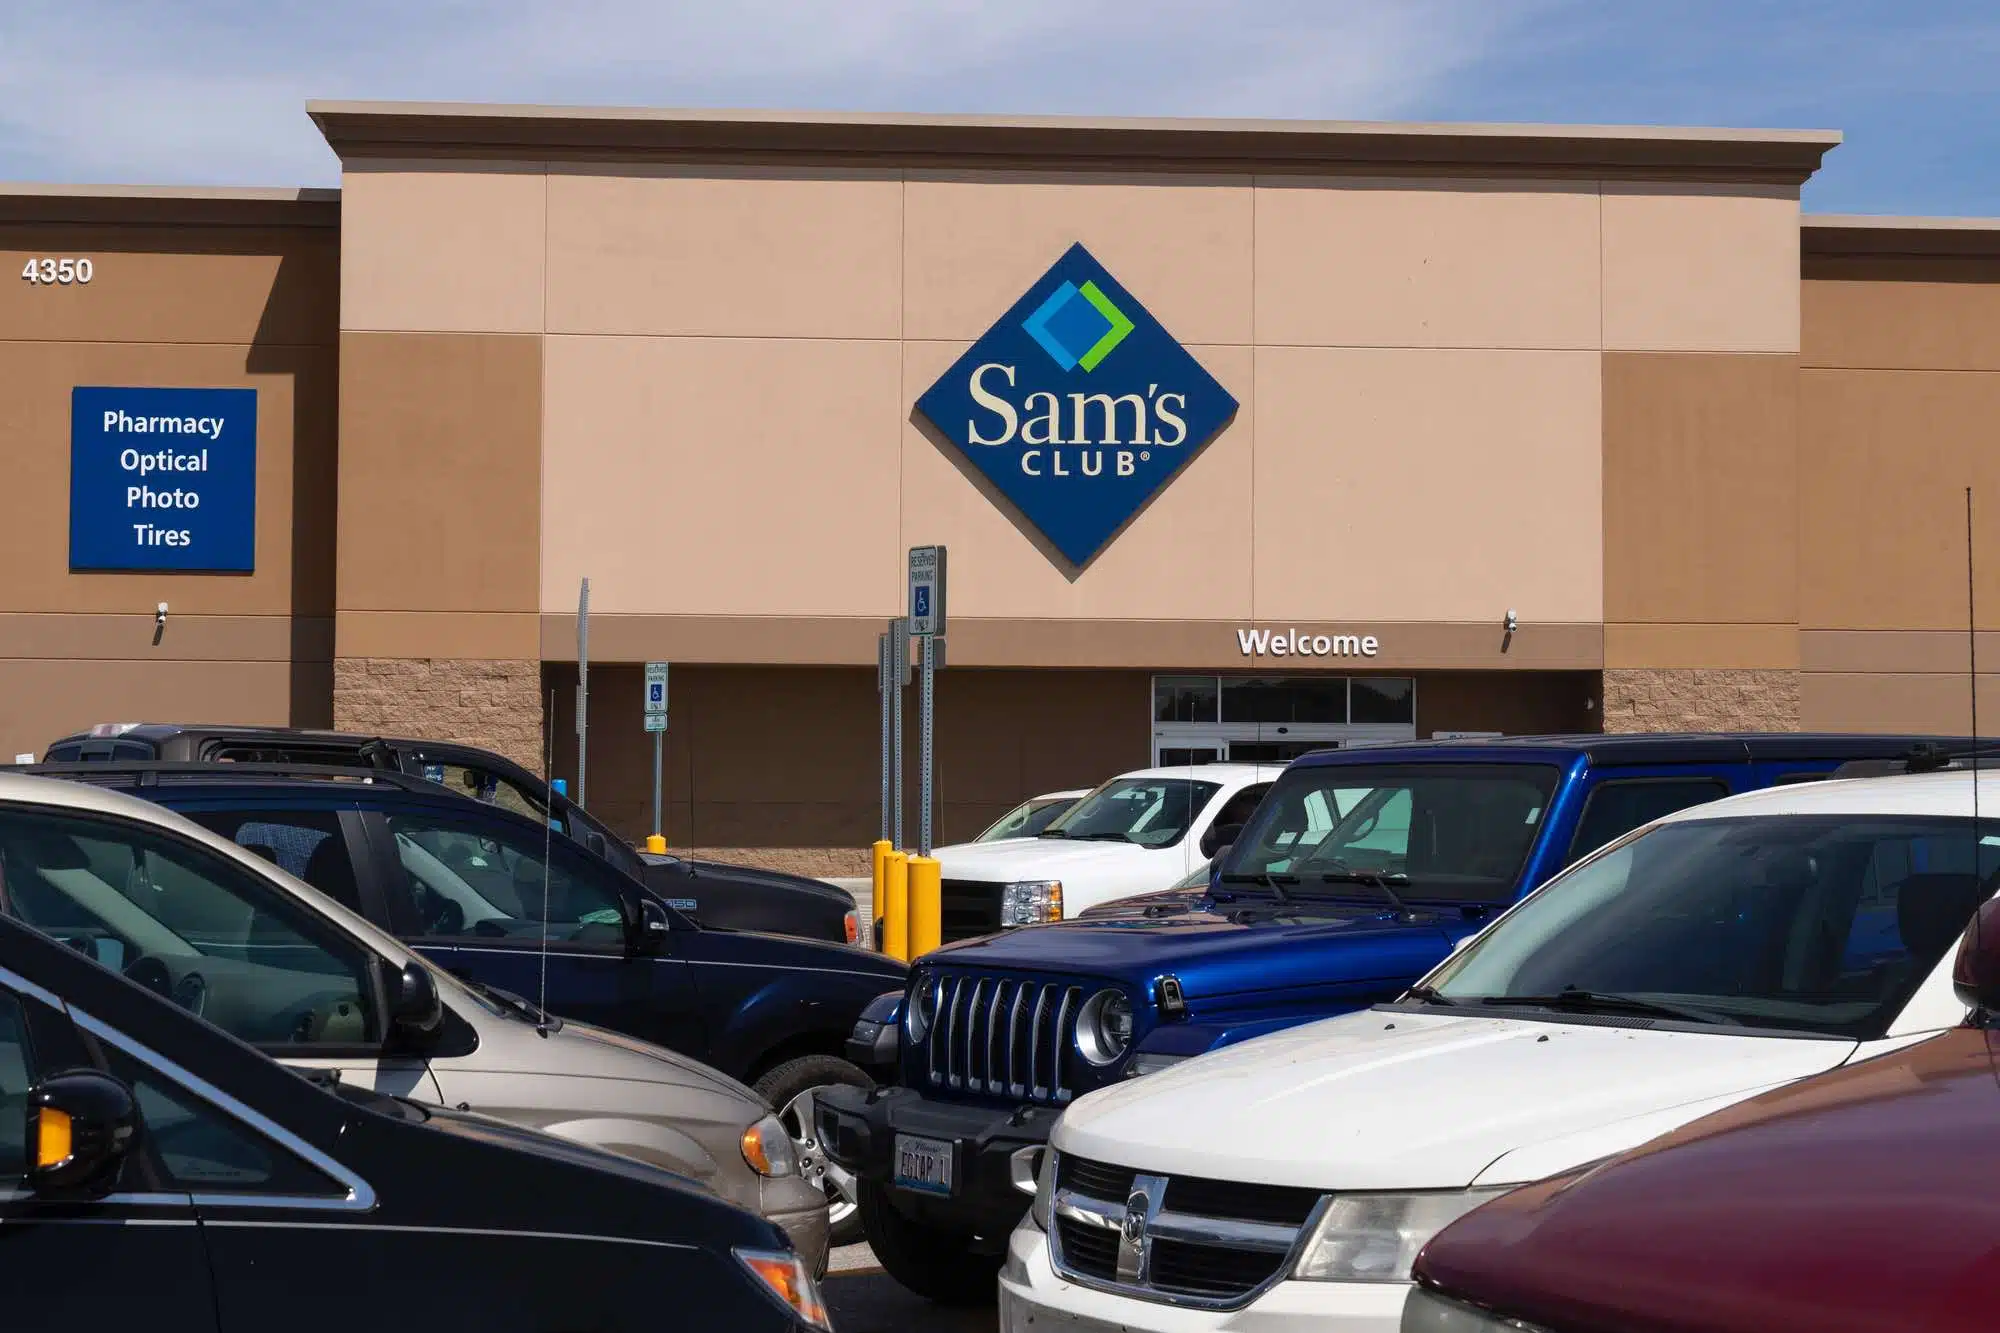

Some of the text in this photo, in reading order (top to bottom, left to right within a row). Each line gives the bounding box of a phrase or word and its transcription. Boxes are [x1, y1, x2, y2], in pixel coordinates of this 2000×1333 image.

[22, 257, 94, 284] 4350
[968, 362, 1188, 447] Sam's
[103, 410, 225, 440] Pharmacy
[120, 447, 208, 476] Optical
[126, 486, 200, 509] Photo
[133, 523, 191, 547] Tires
[911, 554, 935, 568] RESERVED
[911, 570, 933, 582] PARKING
[1237, 628, 1379, 657] Welcome
